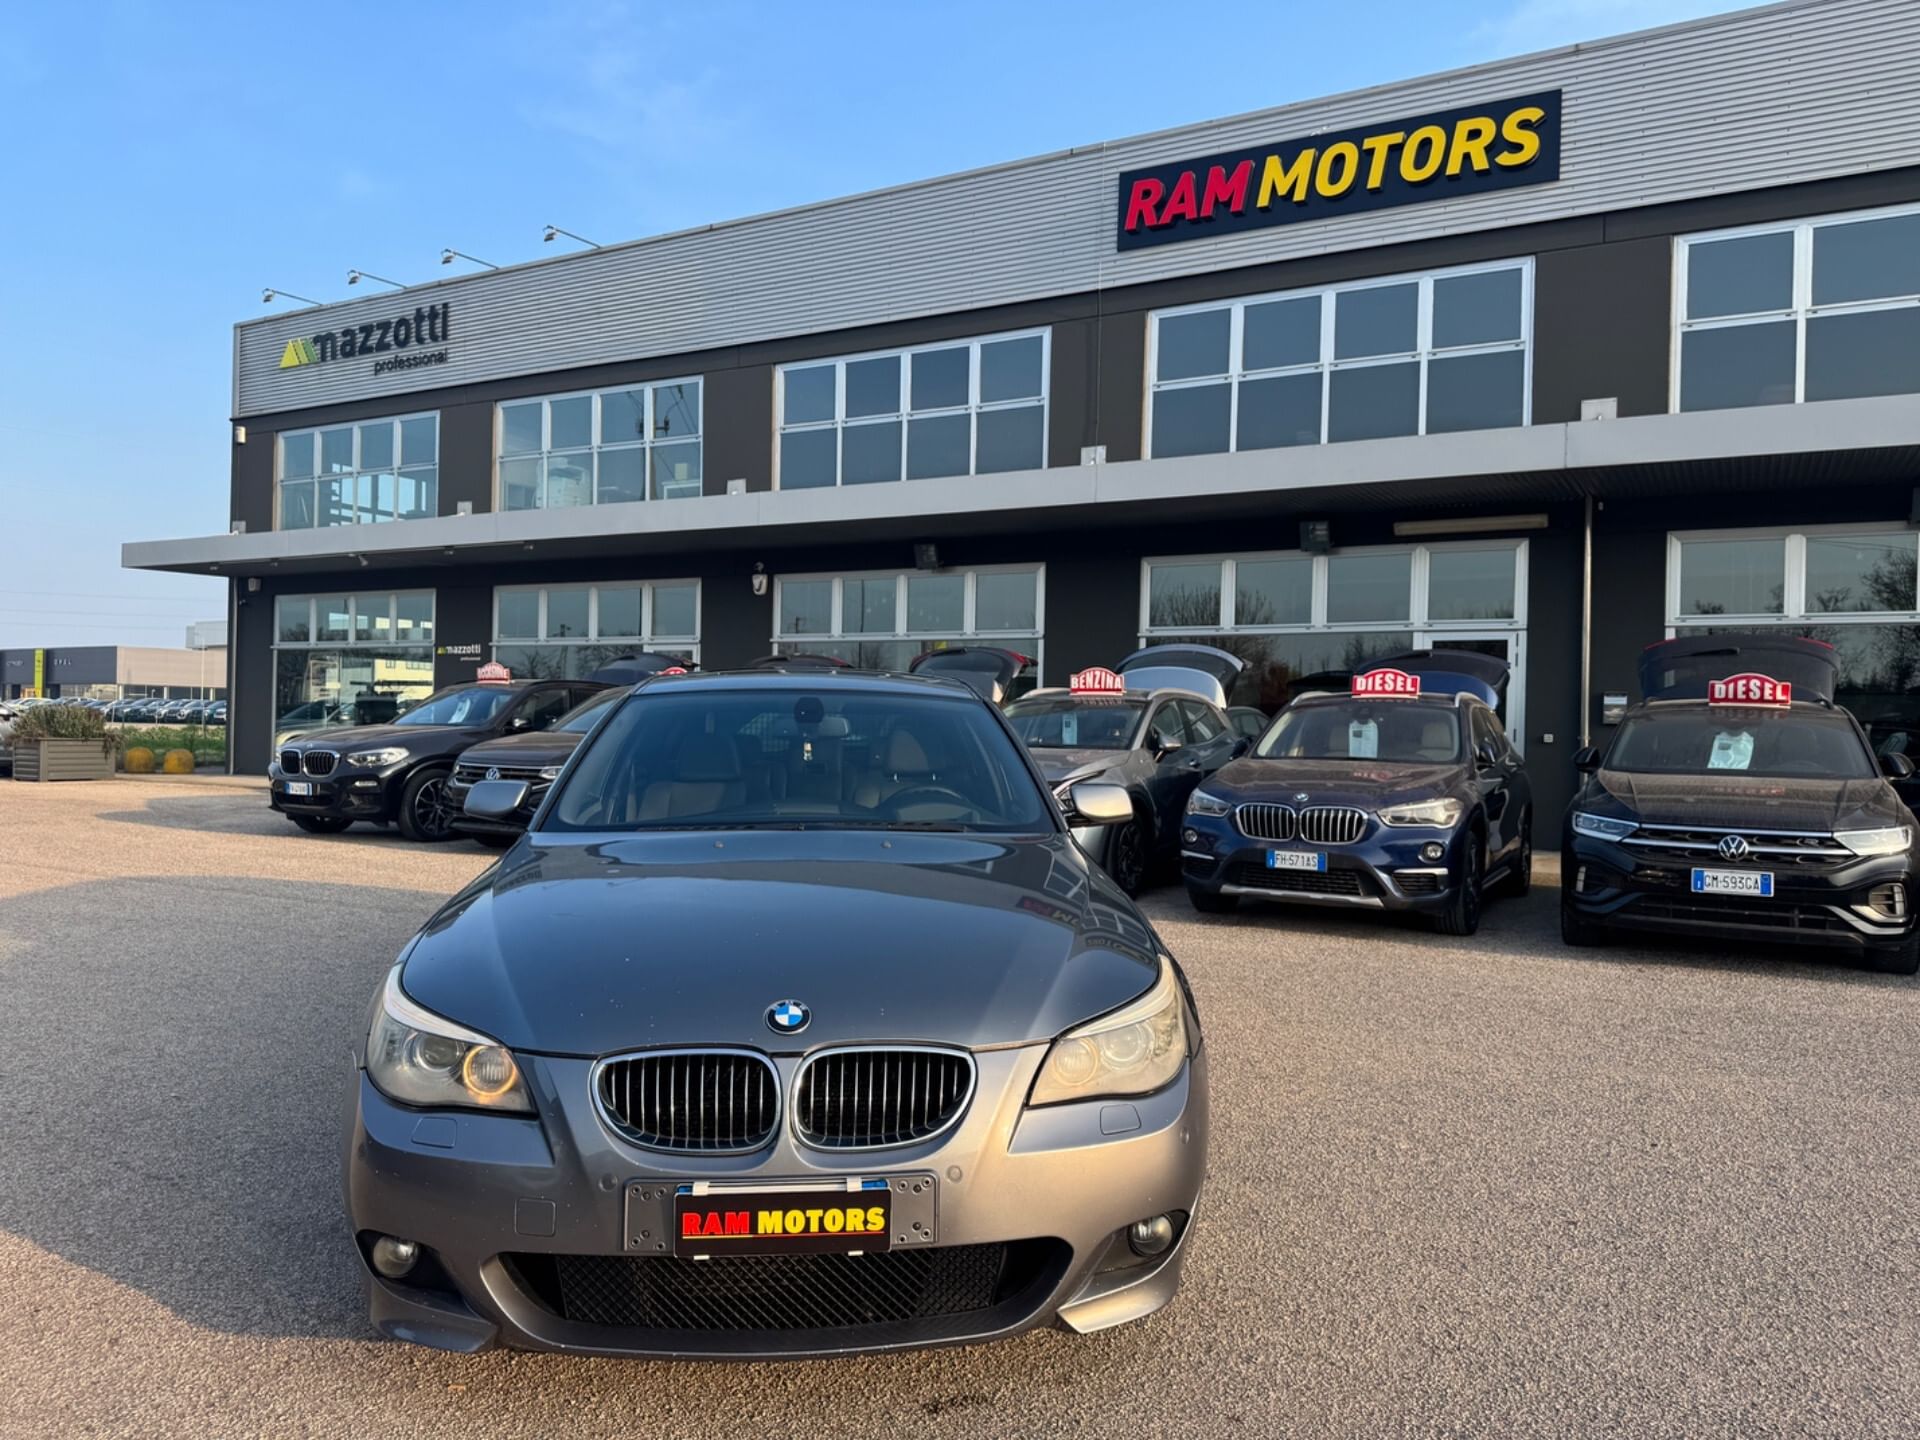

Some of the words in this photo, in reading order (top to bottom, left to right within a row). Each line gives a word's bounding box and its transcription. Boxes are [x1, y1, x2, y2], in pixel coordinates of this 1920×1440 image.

[1124, 160, 1255, 232] RAM
[1256, 106, 1546, 209] MOTORS
[312, 302, 449, 363] mazzotti
[374, 348, 449, 377] professional
[446, 643, 481, 655] mazzotti
[1071, 670, 1122, 689] BENZINA
[1356, 673, 1416, 692] DIESEL
[1714, 679, 1788, 700] DIESEL
[682, 1211, 750, 1235] RAM
[758, 1207, 886, 1234] MOTORS
